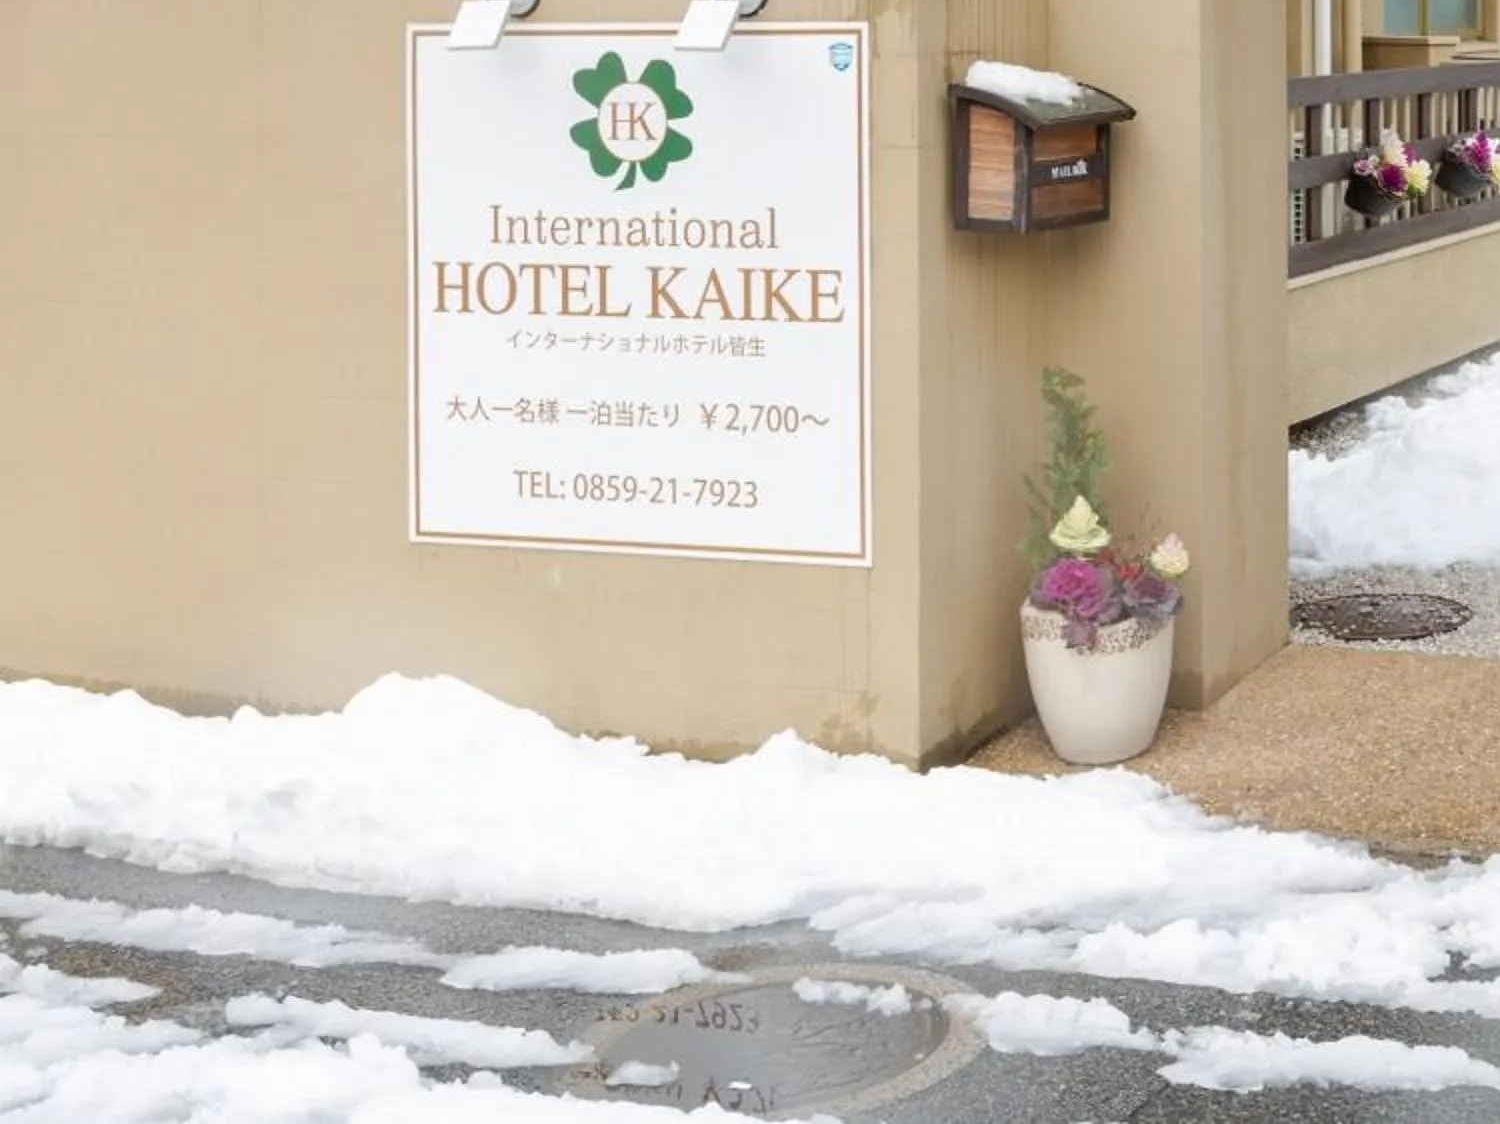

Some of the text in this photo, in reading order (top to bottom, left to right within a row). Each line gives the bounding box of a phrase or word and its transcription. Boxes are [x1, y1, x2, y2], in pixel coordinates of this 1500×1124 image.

[607, 100, 658, 142] HK
[489, 204, 779, 249] International
[432, 260, 846, 323] HOTEL KAIKE
[505, 330, 767, 358] インターナショナルホテル皆生
[513, 470, 759, 509] TEL: 0859-21-7923
